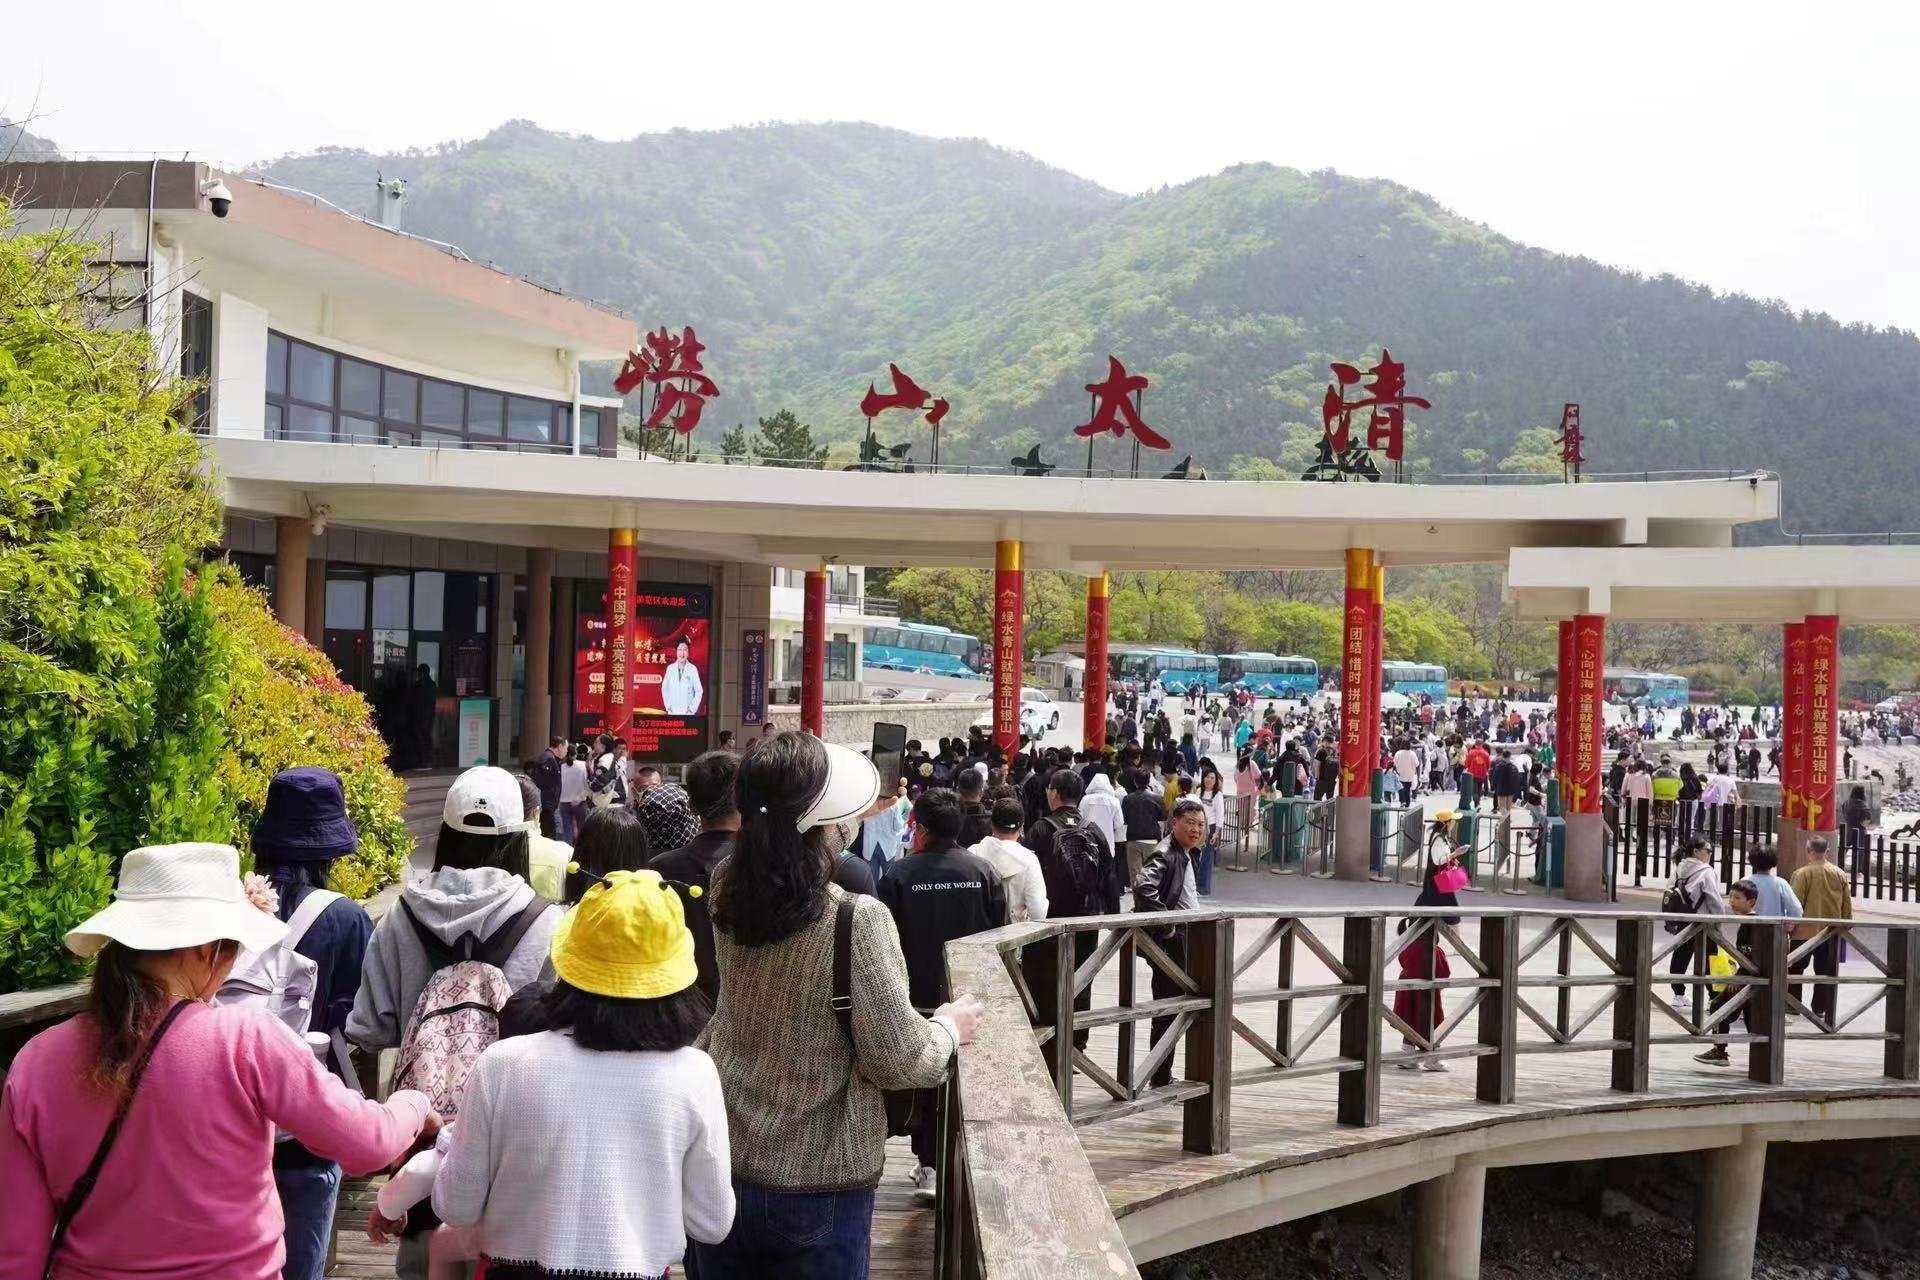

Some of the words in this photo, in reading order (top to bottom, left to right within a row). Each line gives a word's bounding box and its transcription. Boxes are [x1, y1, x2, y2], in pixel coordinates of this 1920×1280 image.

[614, 586, 626, 628] 中国梦
[1350, 628, 1362, 654] 团结
[611, 634, 625, 704] 点亮幸福路
[1001, 611, 1014, 733] 绿水青山就是金山银山
[1581, 649, 1595, 689] 心向山海
[1348, 688, 1360, 715] 拼搏
[1812, 658, 1829, 785] 绿水青山就是金山银山
[1347, 719, 1360, 745] 有为
[1578, 693, 1594, 772] 这里就是诗和远方
[912, 883, 933, 891] ONLY
[934, 882, 952, 890] ONE
